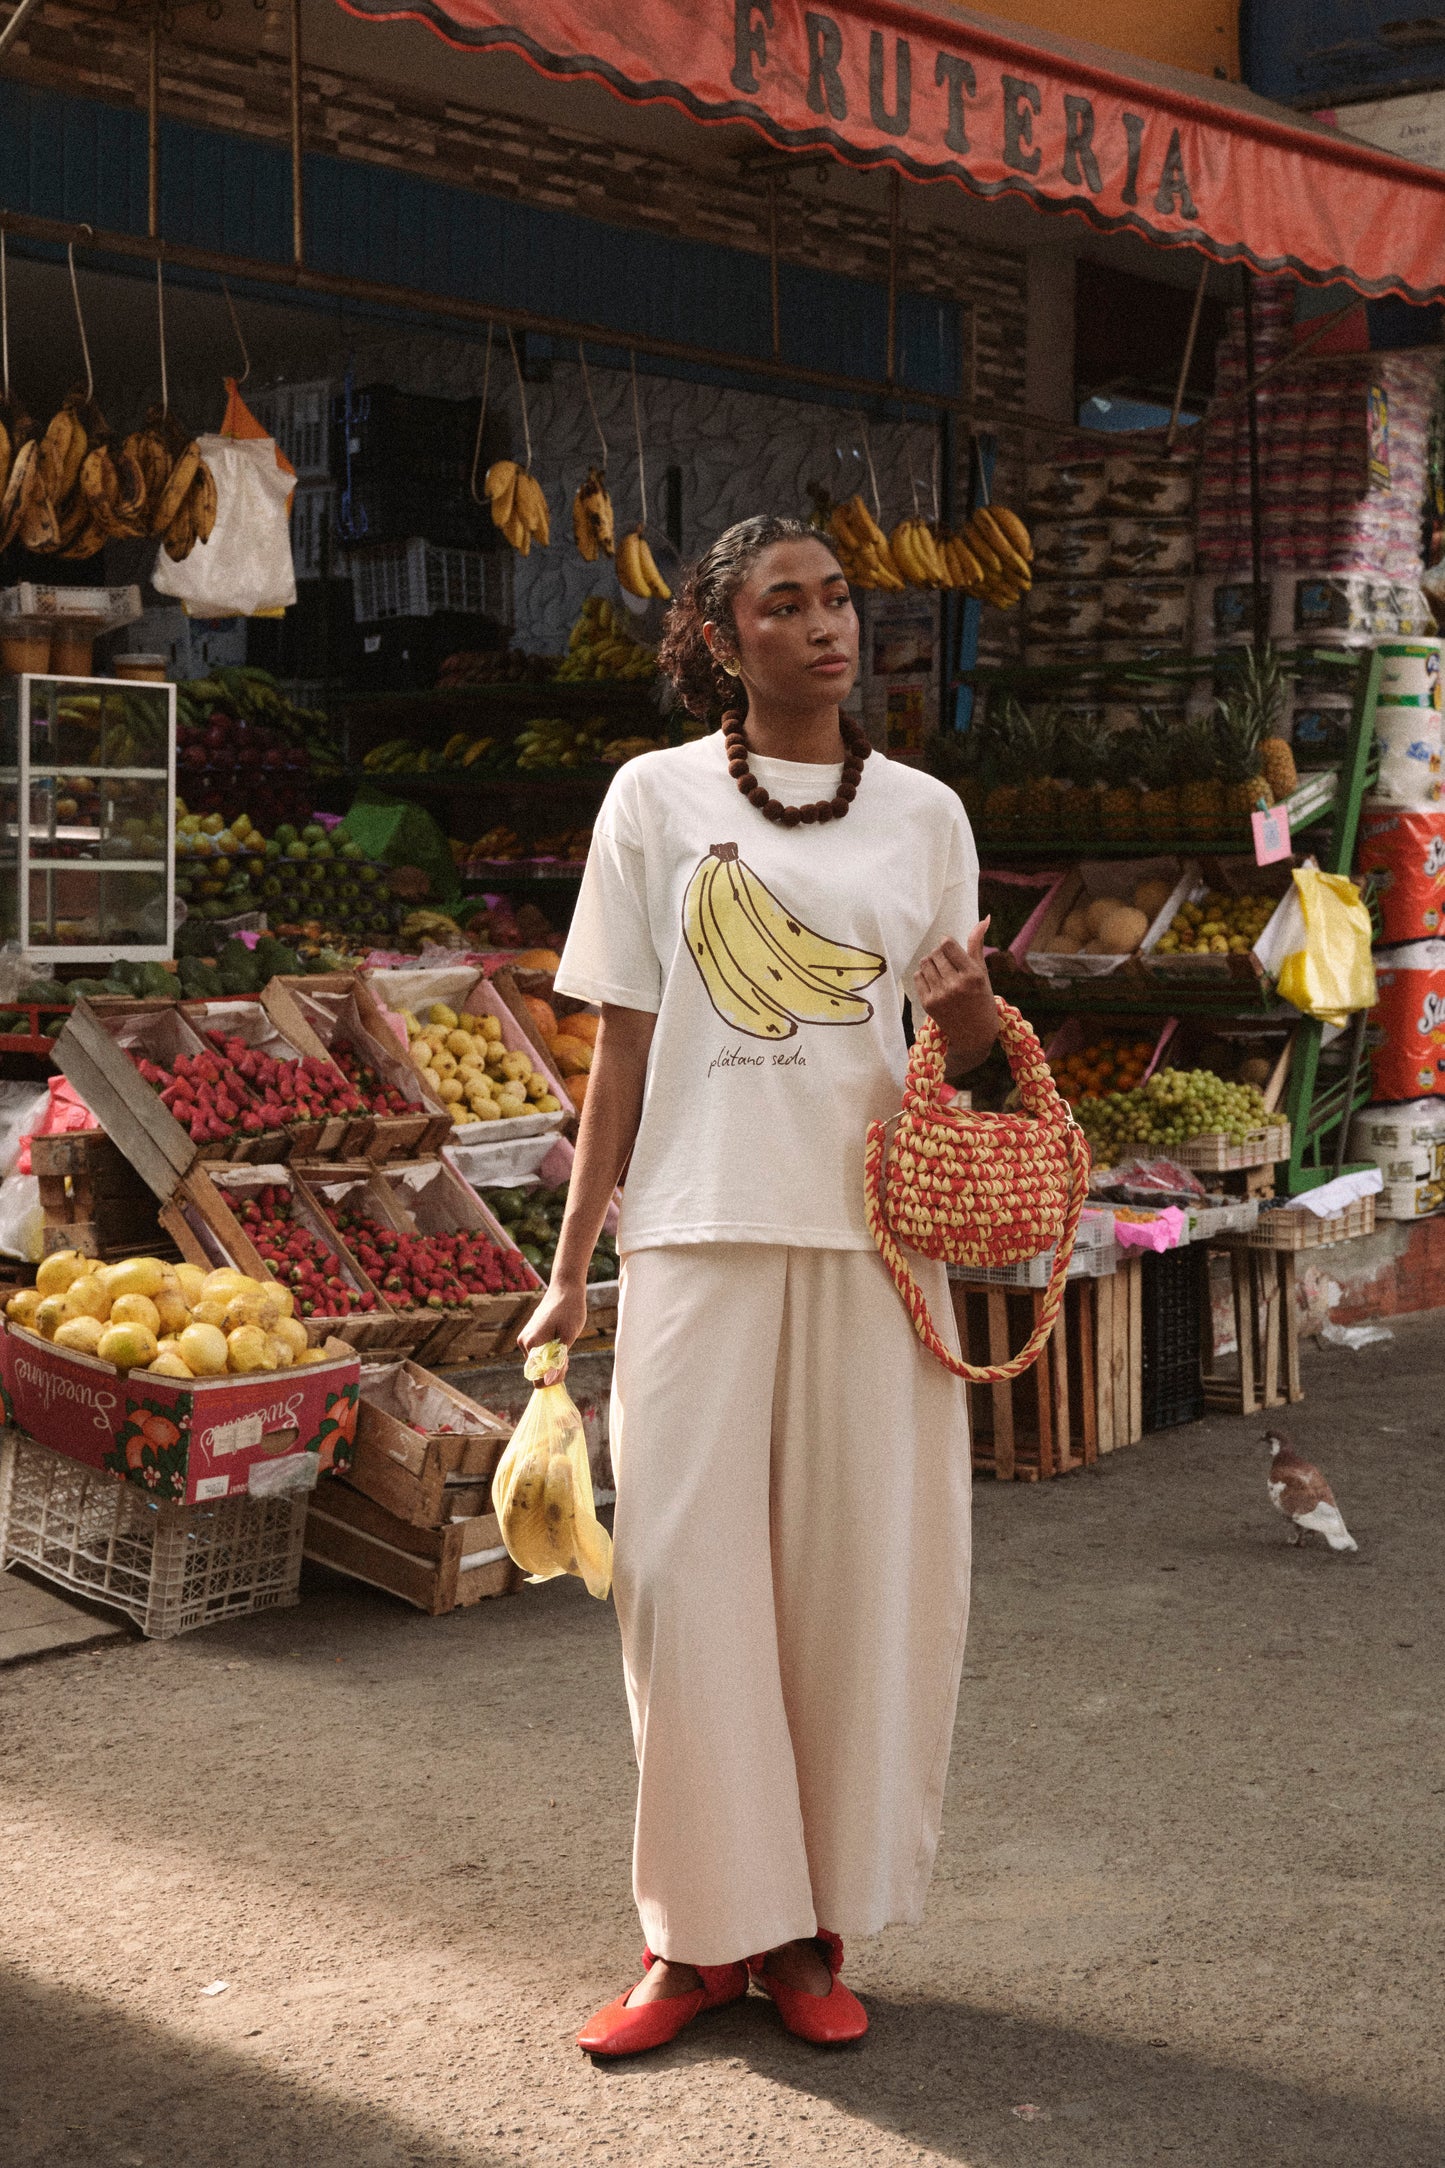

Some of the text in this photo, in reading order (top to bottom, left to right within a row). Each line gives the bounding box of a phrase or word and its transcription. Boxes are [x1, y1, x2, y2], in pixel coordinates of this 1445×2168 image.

[730, 0, 1199, 220] FRUTERIA
[707, 1044, 807, 1078] plátano seda
